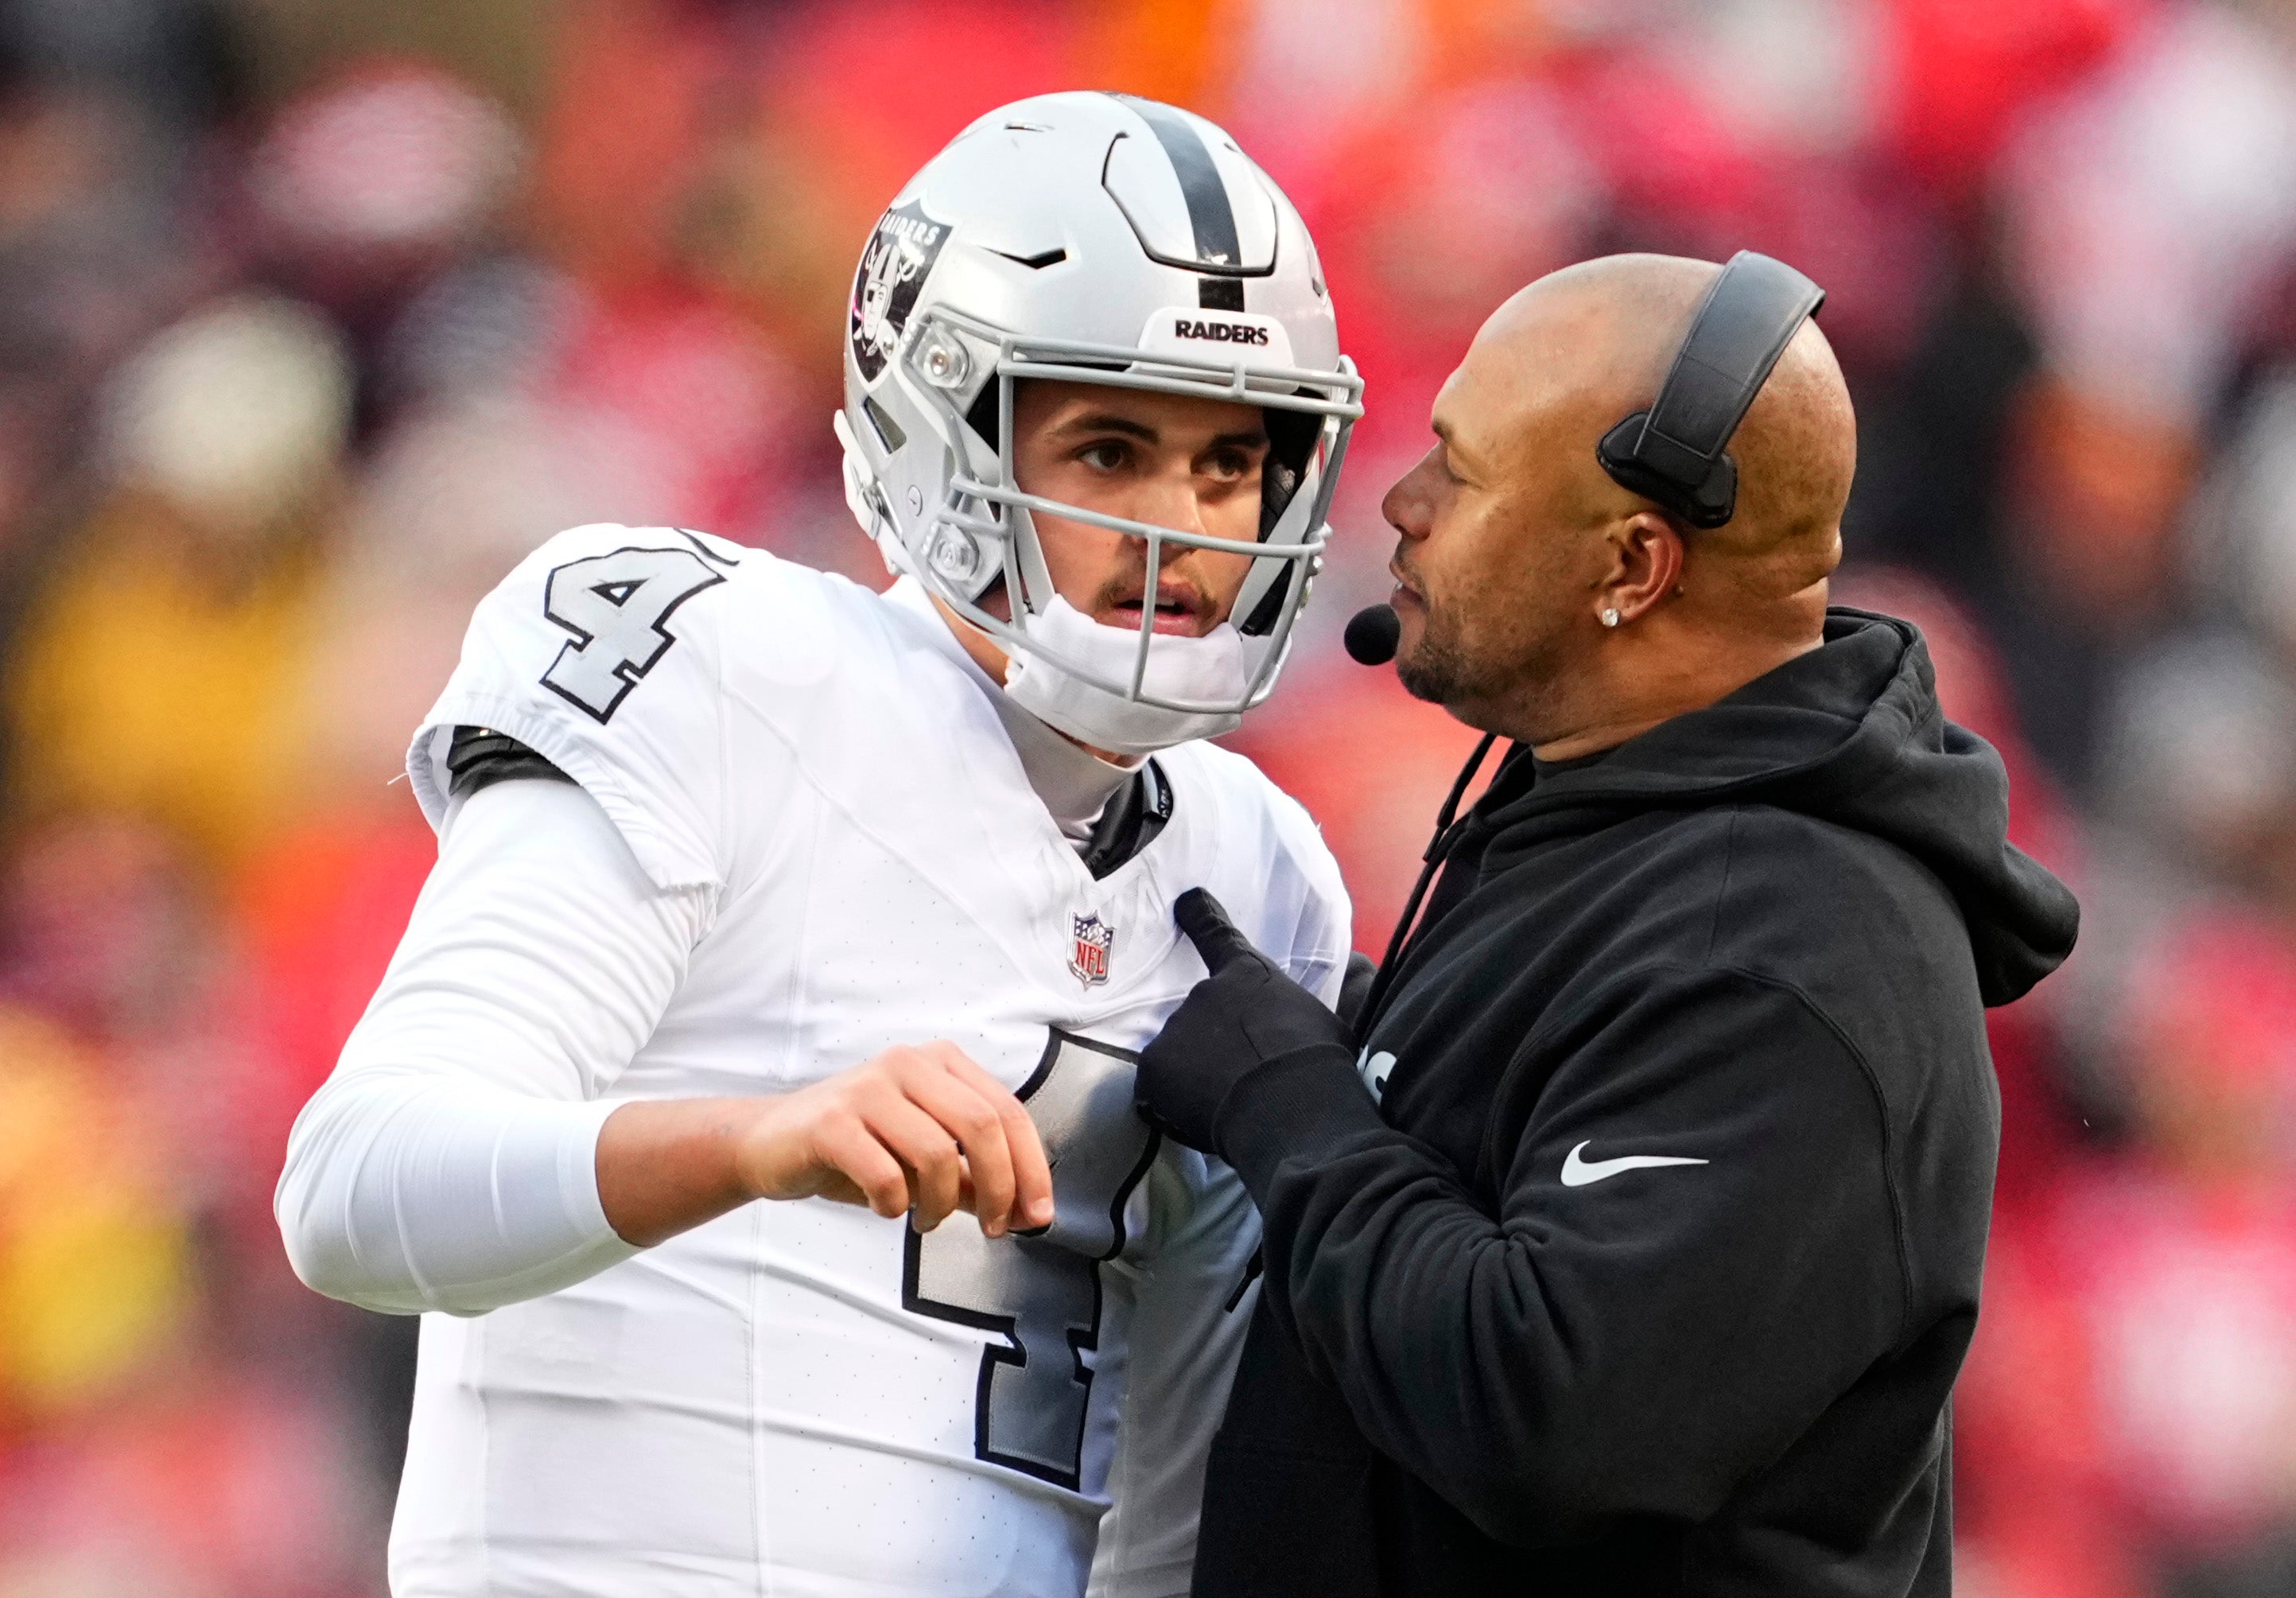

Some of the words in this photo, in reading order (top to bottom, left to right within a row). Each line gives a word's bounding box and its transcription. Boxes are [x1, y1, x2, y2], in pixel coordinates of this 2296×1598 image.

[880, 212, 940, 247] RAIDERS
[1175, 320, 1268, 346] RAIDERS
[539, 546, 728, 725] 4
[1075, 940, 1105, 974] NFL
